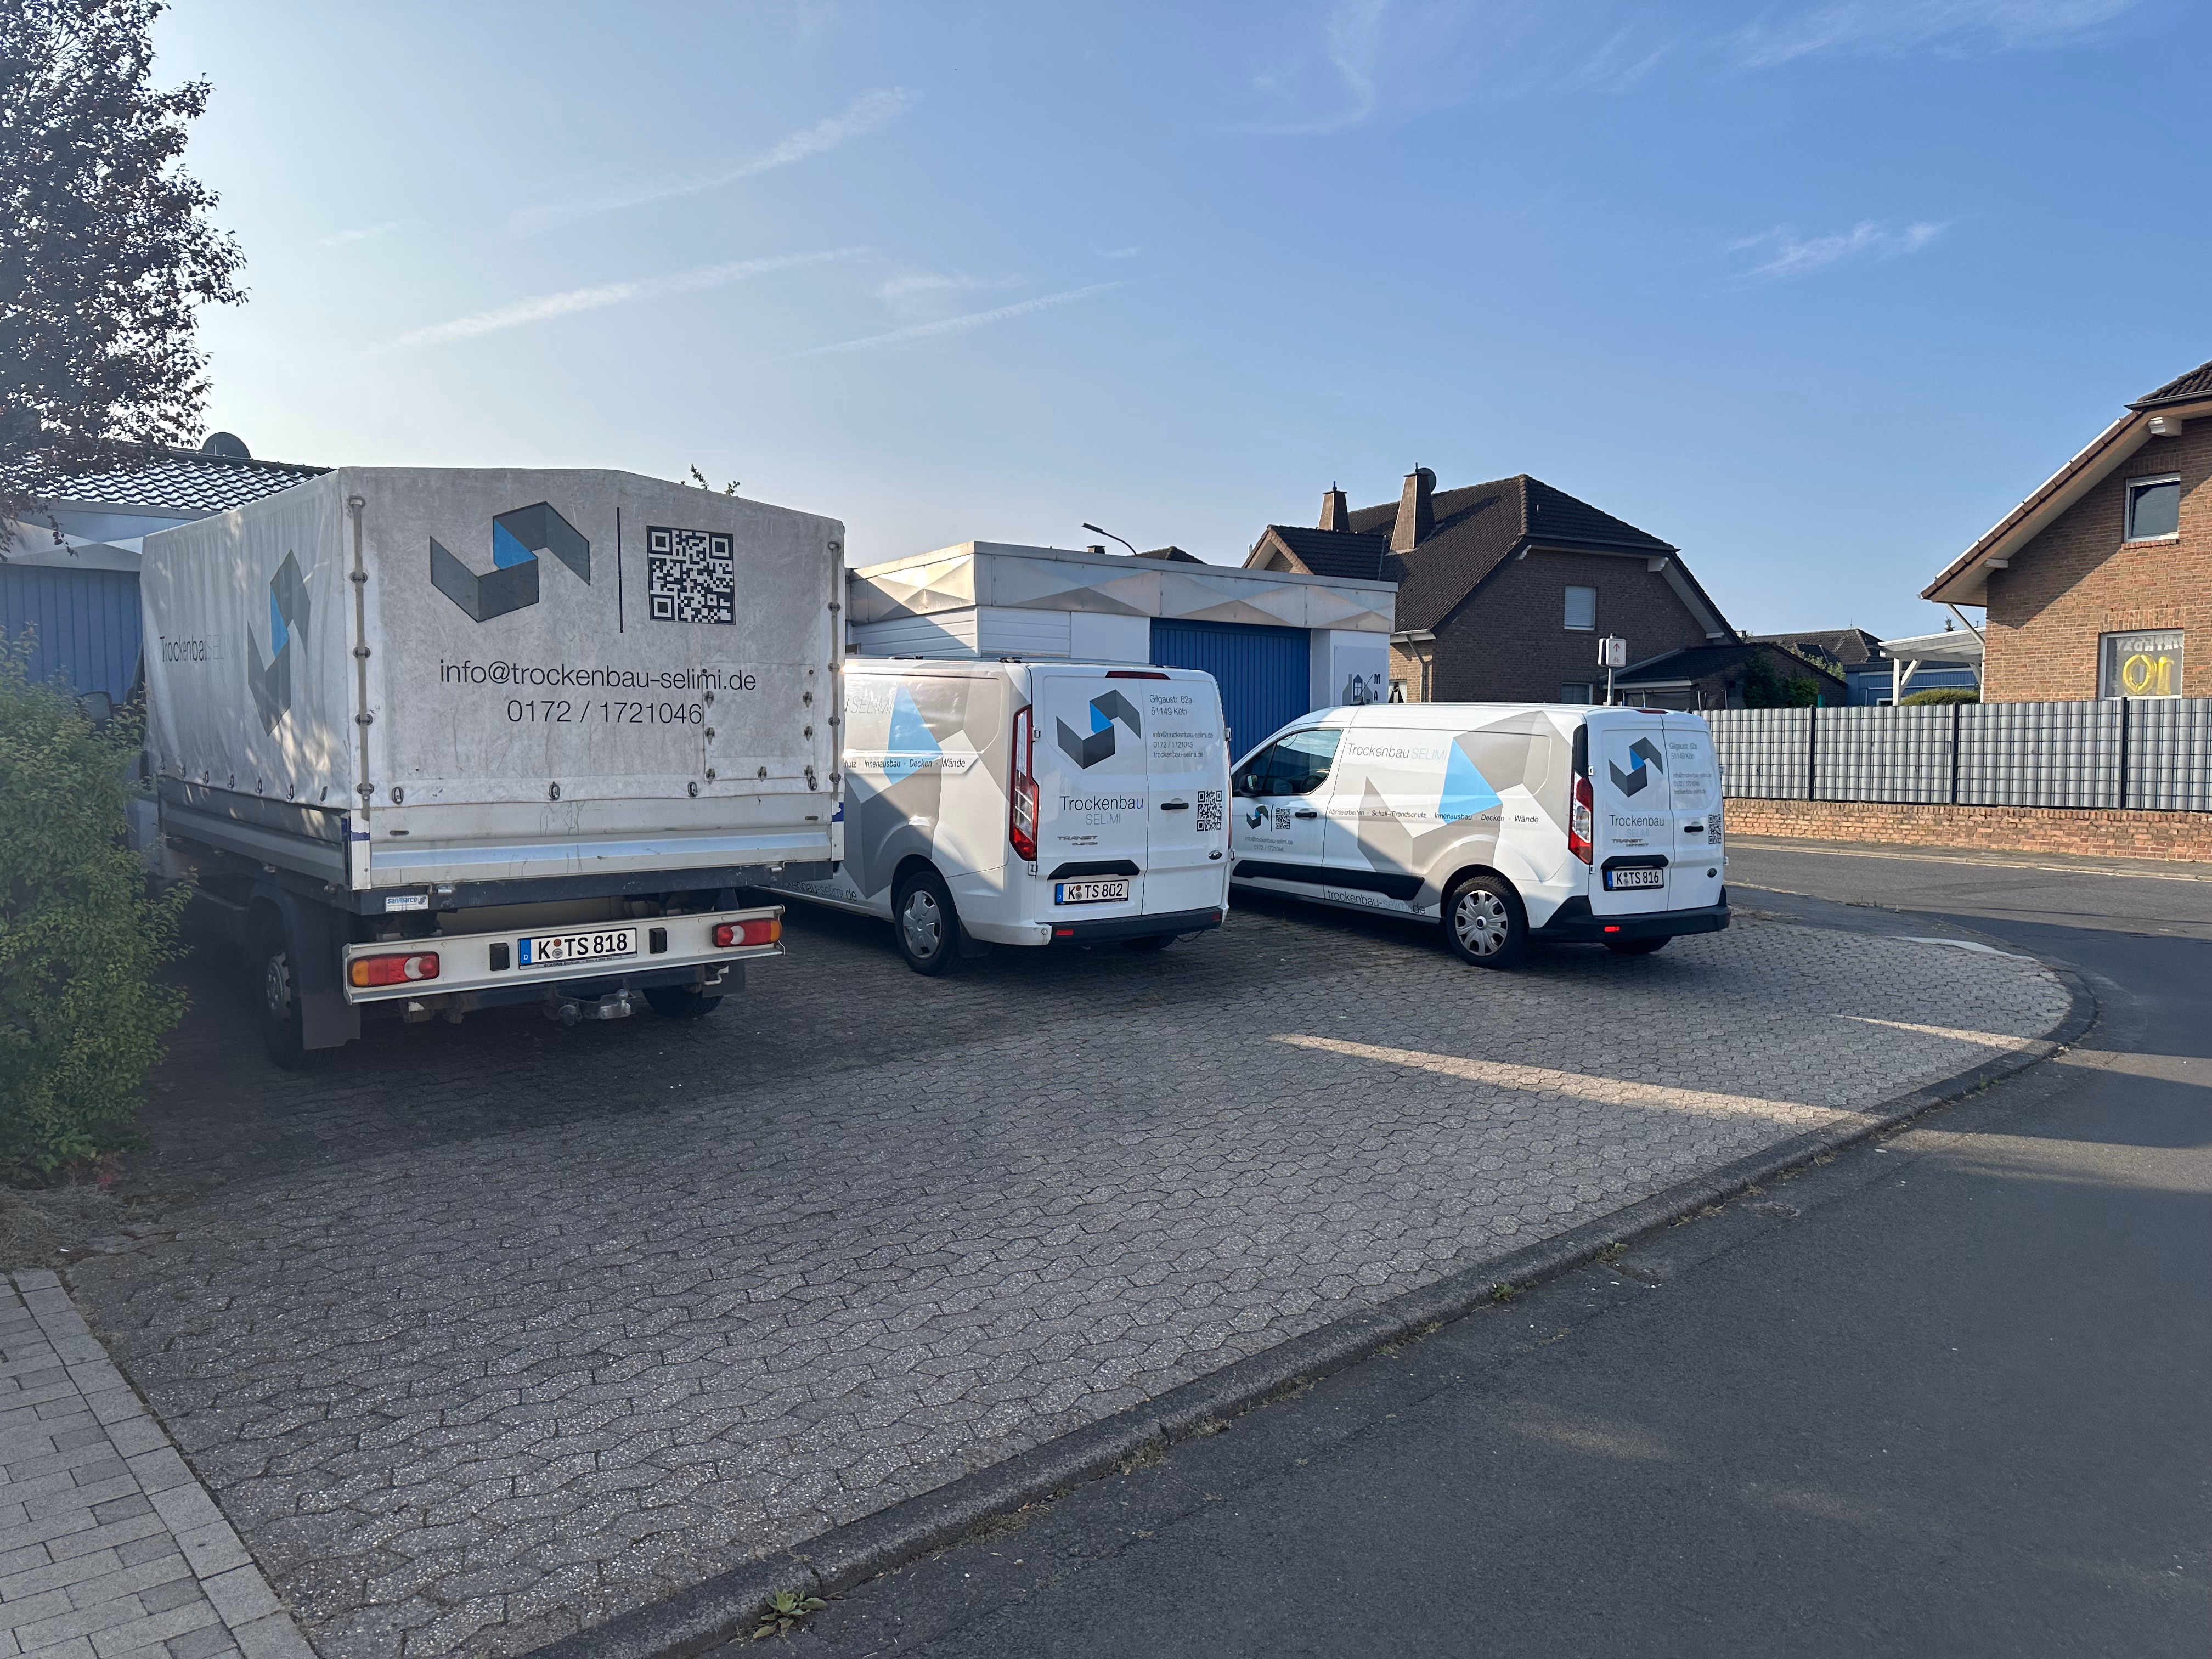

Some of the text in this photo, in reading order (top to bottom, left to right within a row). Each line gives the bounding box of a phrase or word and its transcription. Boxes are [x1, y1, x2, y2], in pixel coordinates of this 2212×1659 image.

[441, 659, 756, 690] info@trockenbau-selimi.de
[850, 695, 893, 714] SELIMI
[1181, 695, 1193, 704] 62a
[507, 699, 702, 725] 0172 / 1721046
[1151, 707, 1188, 715] 51149 Köln
[1348, 743, 1448, 761] Trockenbau SELIMI
[844, 758, 966, 768] hutz Innenausbau Decken Wände
[1059, 795, 1143, 811] Trockenbau
[1085, 813, 1121, 825] SELIMI
[1372, 810, 1426, 819] Schall-/Brandschutz
[1514, 814, 1539, 823] Wände
[1609, 815, 1664, 827] Trockenbau
[1616, 871, 1659, 885] K TS 816
[1068, 883, 1123, 899] K TS 802
[387, 896, 417, 904] sanmarco
[538, 933, 627, 960] K TS 818
